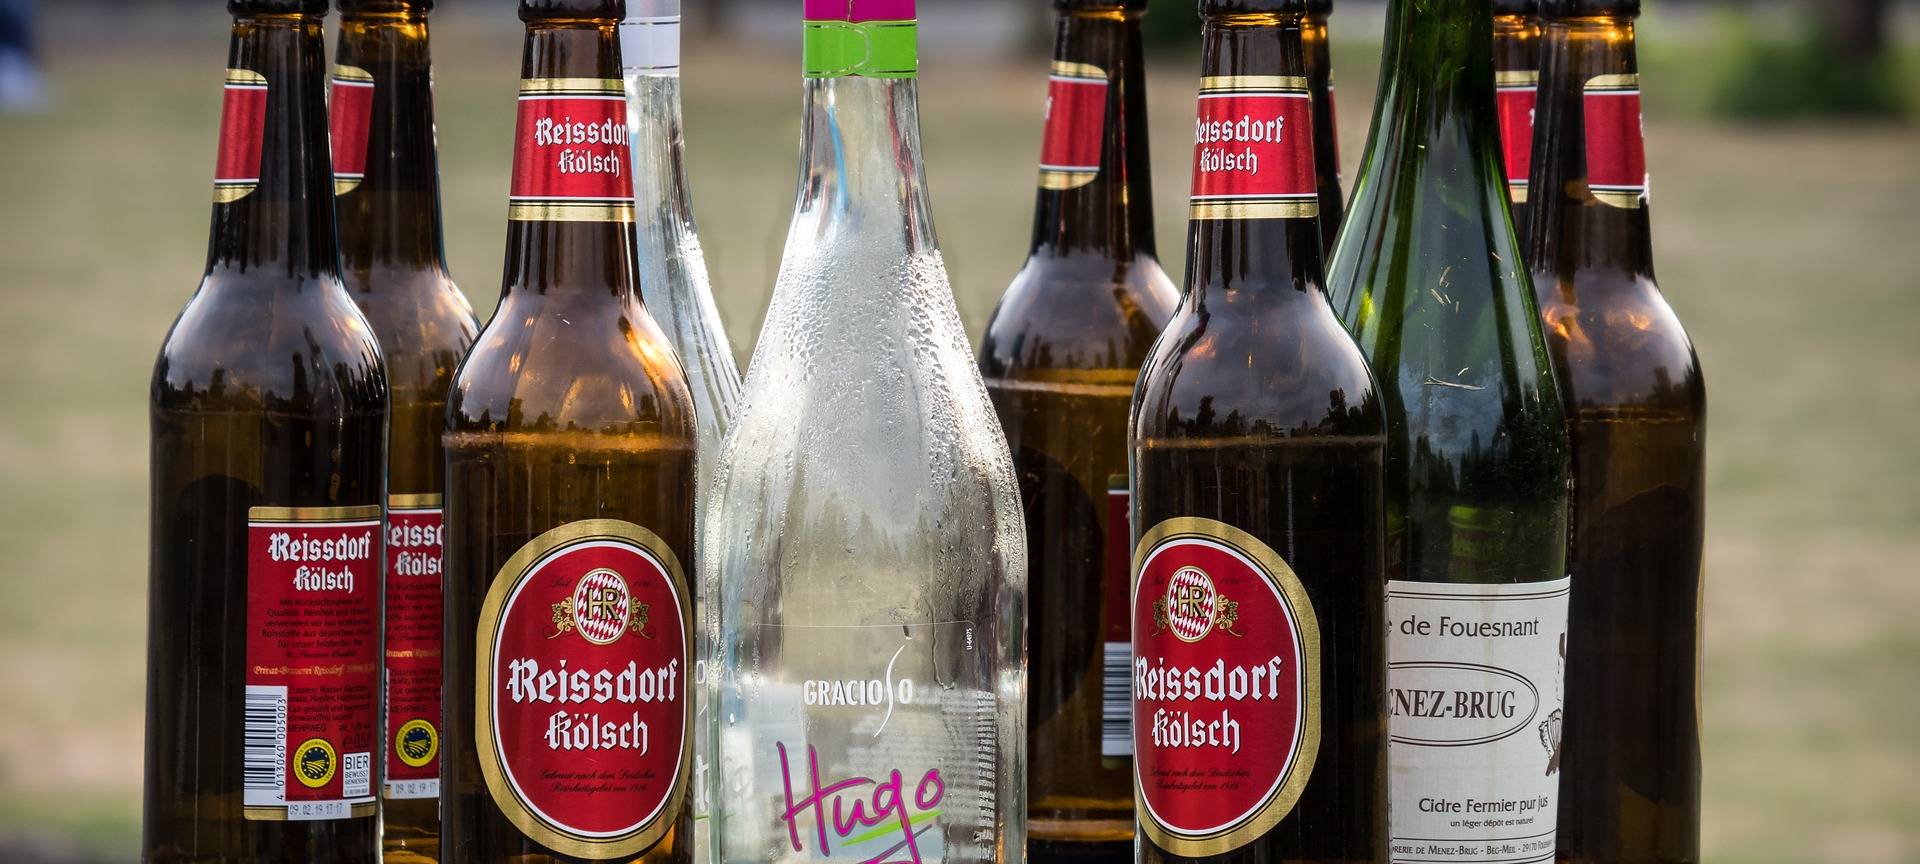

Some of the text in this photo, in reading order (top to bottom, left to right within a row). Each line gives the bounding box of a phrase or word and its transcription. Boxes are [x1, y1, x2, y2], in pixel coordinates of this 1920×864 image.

[557, 148, 620, 179] Kölsch
[1200, 146, 1258, 176] Kölsch
[268, 531, 372, 562] Reissdorf
[293, 565, 354, 594] Kölsch
[1400, 614, 1431, 636] de
[1439, 615, 1540, 638] Fouesnant
[506, 656, 678, 704] Reissdorf
[1134, 655, 1283, 702] Reissdorf
[276, 698, 286, 740] 005003
[544, 709, 648, 757] Kölsch
[1151, 707, 1240, 755] Kölsch
[276, 745, 285, 787] 013060
[345, 755, 369, 770] BIER
[776, 739, 945, 864] Hugo
[1418, 794, 1549, 814] Cidre Fermier pur jus
[1450, 820, 1460, 828] un
[1462, 818, 1481, 830] léger
[1483, 818, 1504, 829] dépôt
